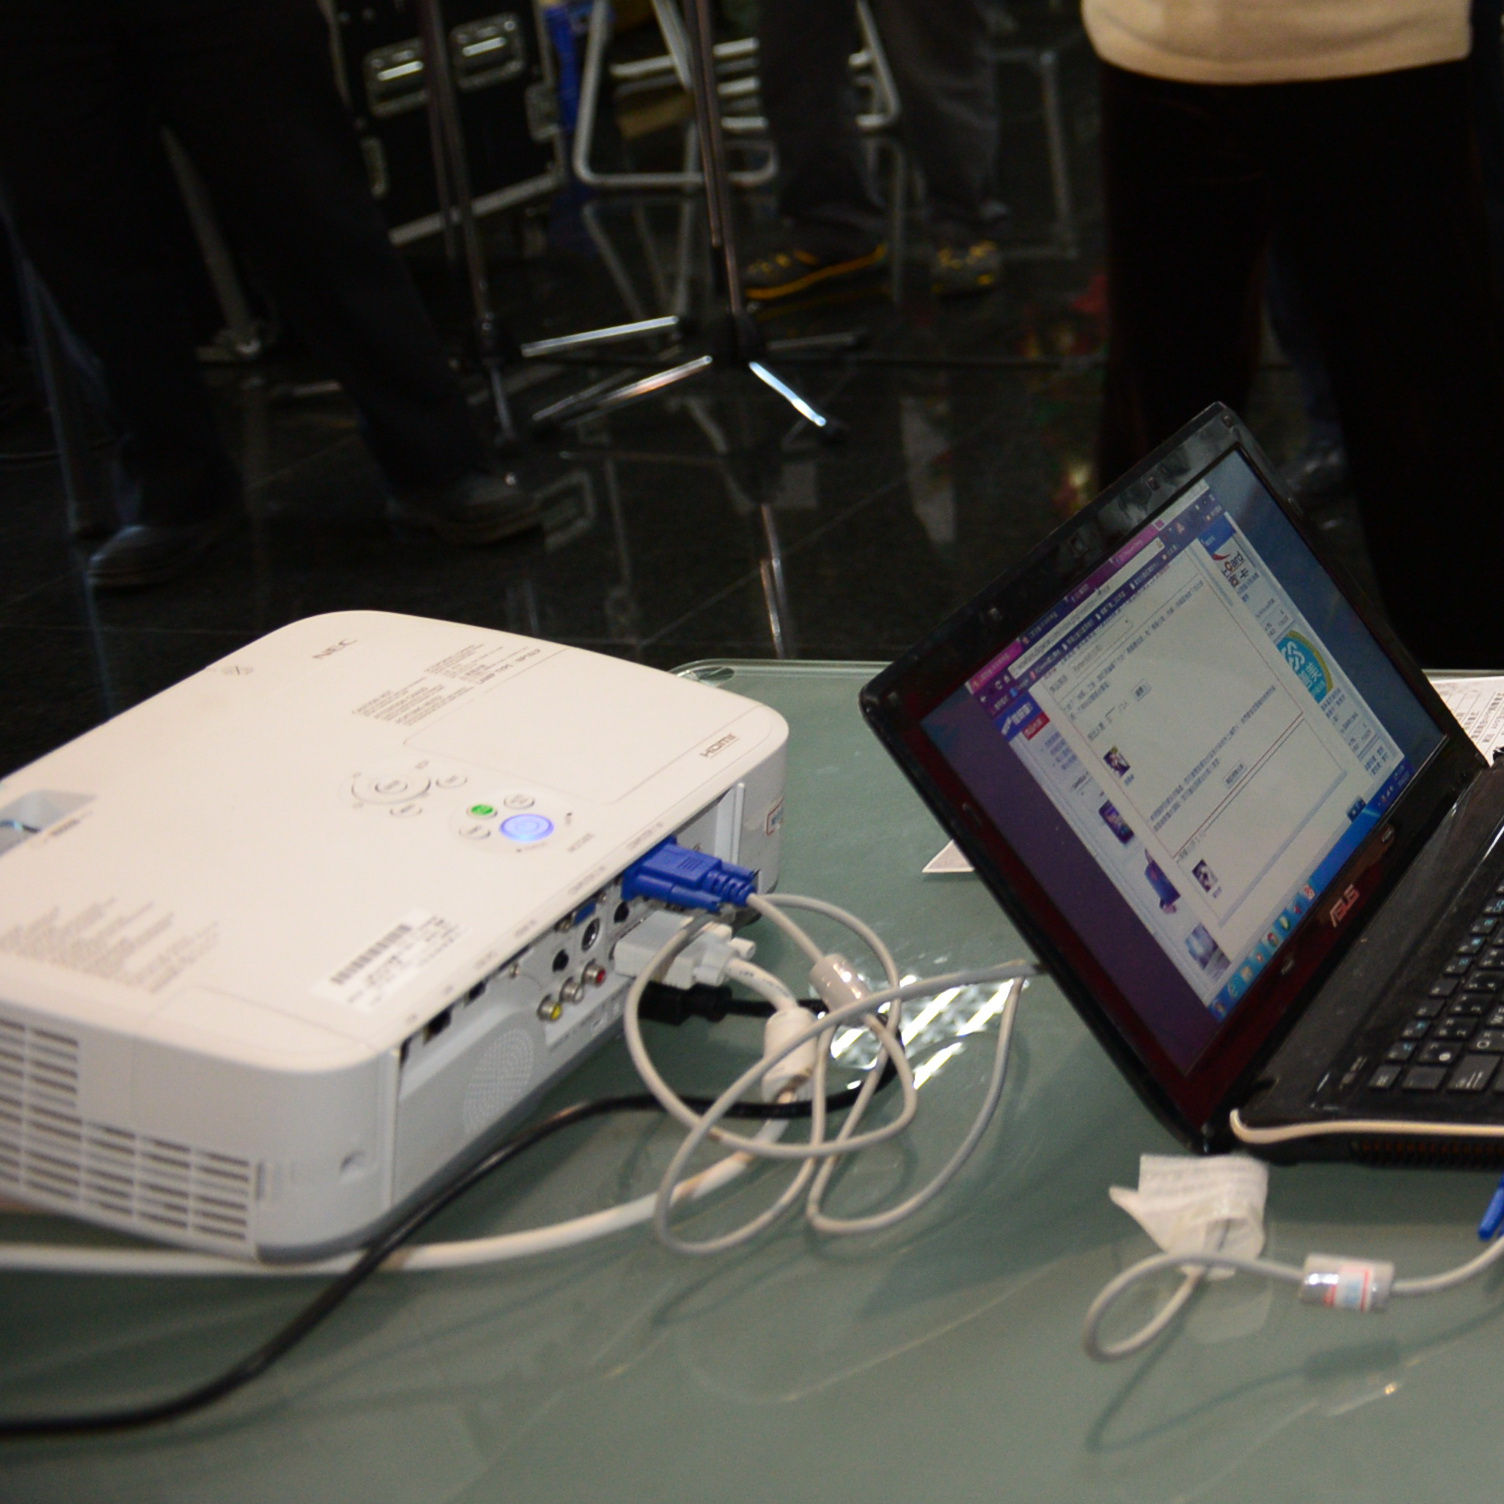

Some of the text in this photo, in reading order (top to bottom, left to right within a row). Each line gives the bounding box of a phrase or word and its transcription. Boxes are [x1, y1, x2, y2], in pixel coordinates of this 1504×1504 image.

[312, 638, 358, 659] NEC
[699, 732, 738, 756] HDMI
[1329, 883, 1360, 928] ASUS
